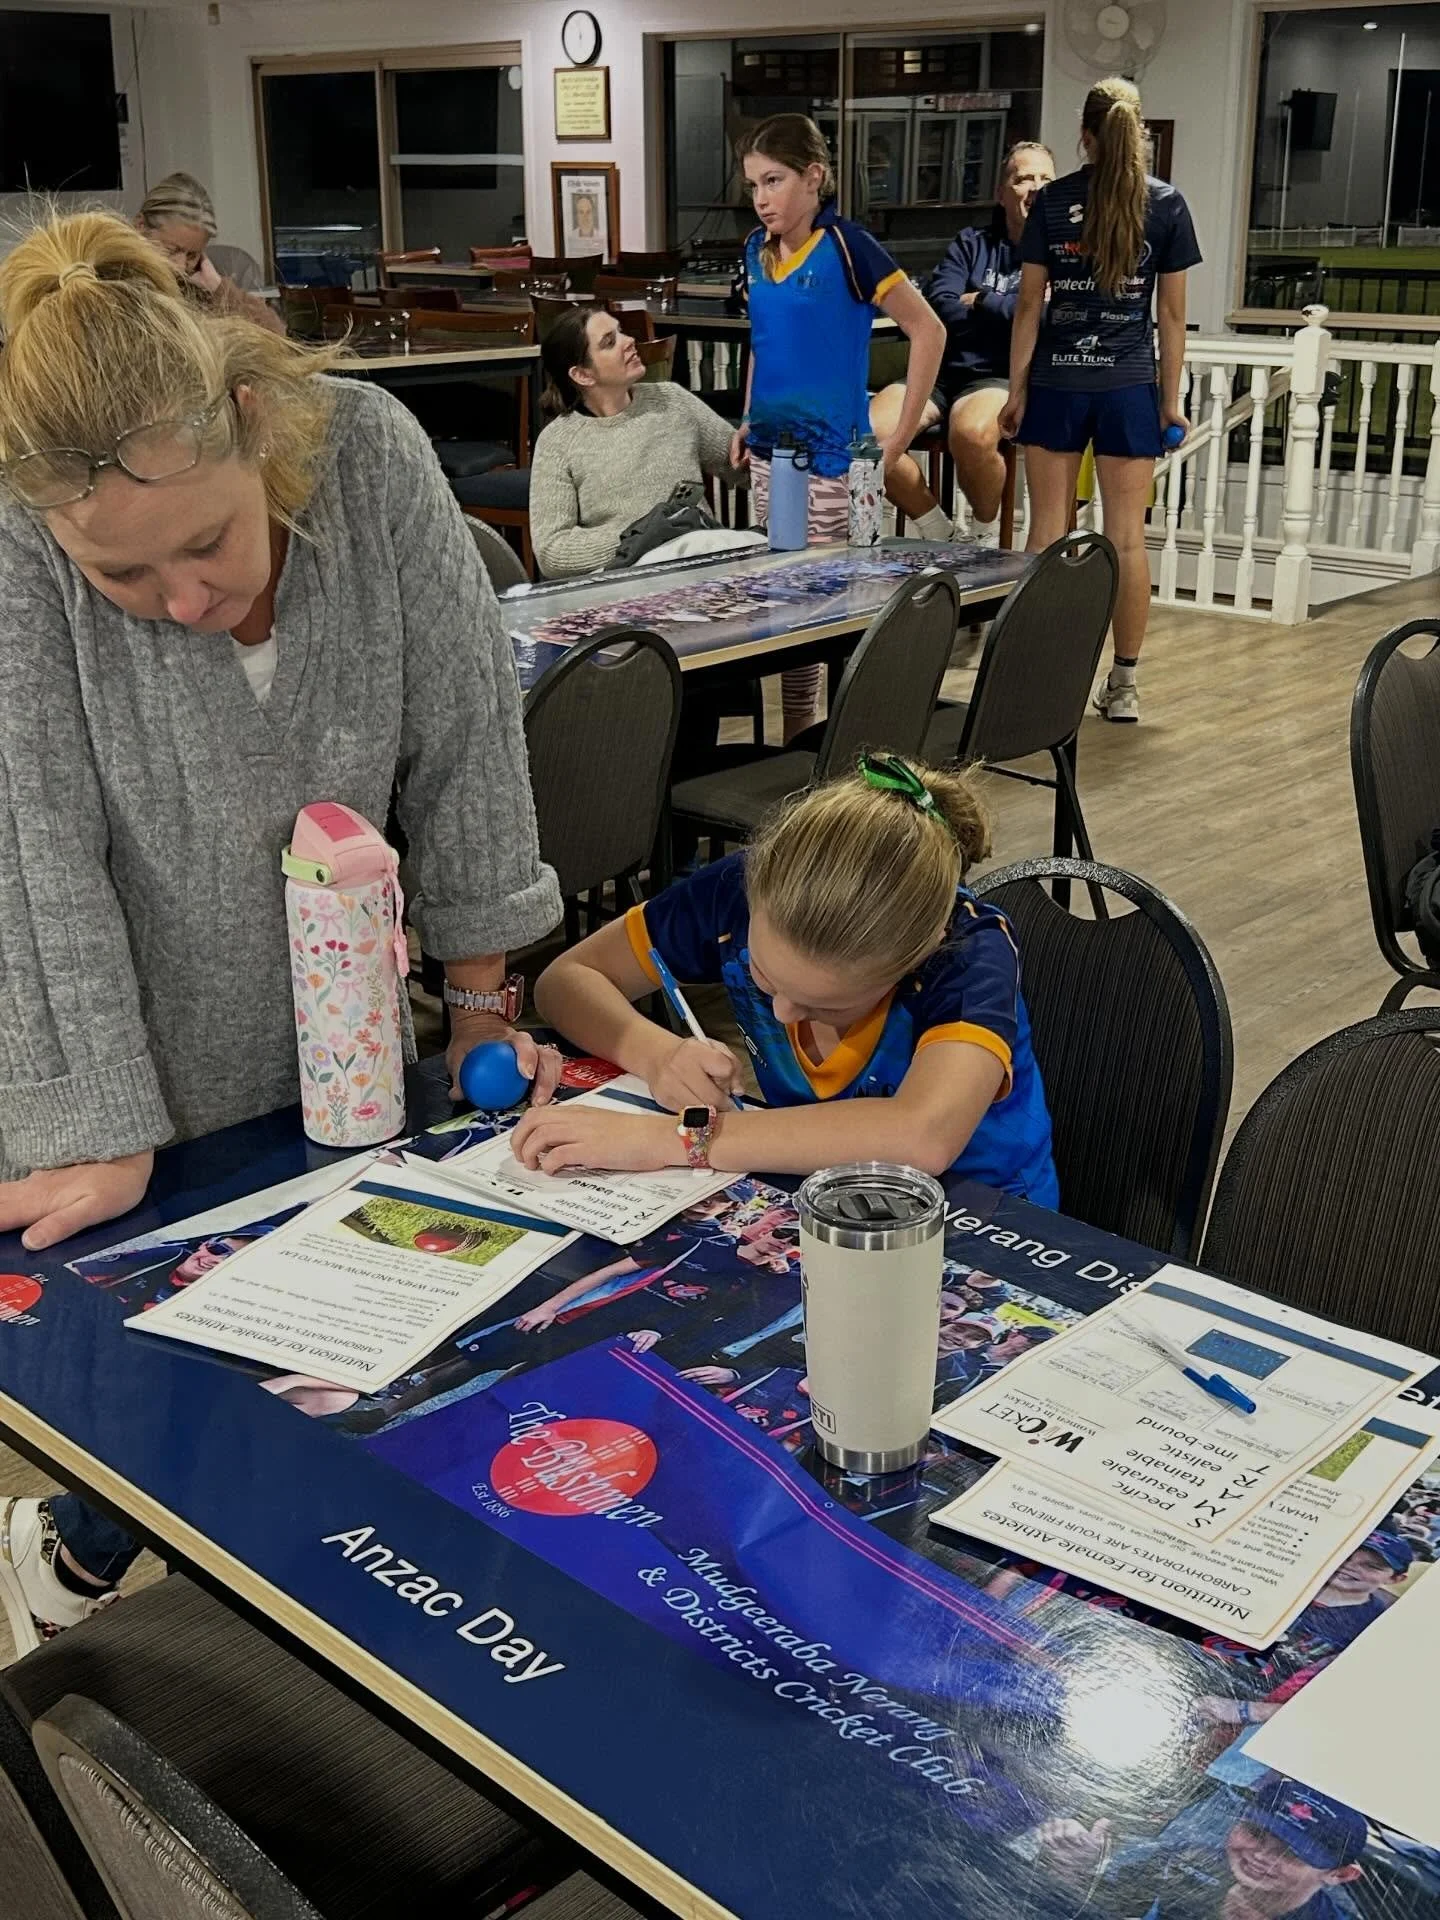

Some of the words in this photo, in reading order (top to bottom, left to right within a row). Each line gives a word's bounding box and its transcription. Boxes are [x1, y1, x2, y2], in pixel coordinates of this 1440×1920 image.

[1052, 353, 1080, 362] ELITE
[1081, 354, 1116, 363] TILING
[175, 1311, 233, 1331] Athletes
[202, 1303, 244, 1318] FRIENDS
[242, 1314, 272, 1326] YOUR
[231, 1326, 286, 1346] Female
[274, 1322, 293, 1331] ARE
[284, 1340, 308, 1353] for
[295, 1327, 383, 1354] CARBOHYDRATES
[308, 1347, 376, 1372] Nutrition
[508, 1402, 568, 1446] The
[1135, 1416, 1238, 1461] ime-bound
[1125, 1449, 1205, 1487] ttainable
[1159, 1443, 1222, 1471] ealistic
[1246, 1464, 1270, 1475] T
[521, 1438, 664, 1529] Bushmen
[1101, 1458, 1188, 1499] easurable
[1232, 1473, 1258, 1488] R
[471, 1482, 490, 1501] Est
[1111, 1480, 1175, 1510] pecific
[1217, 1487, 1244, 1499] A
[1010, 1501, 1064, 1526] FRIENDS
[1193, 1498, 1226, 1517] M
[982, 1510, 1055, 1542] Athletes
[1063, 1521, 1101, 1541] YOUR
[1186, 1517, 1211, 1528] S
[1057, 1539, 1126, 1571] Female
[1103, 1536, 1131, 1550] ARE
[1127, 1567, 1157, 1583] for
[1133, 1547, 1251, 1596] CARBOHYDRATES
[319, 1525, 464, 1619] Anzac
[456, 1606, 565, 1684] Day
[1160, 1578, 1250, 1620] Nutrition
[678, 1548, 837, 1675] Mudgeeraba
[829, 1672, 957, 1742] Nerang
[638, 1566, 667, 1588] &
[662, 1587, 780, 1681] Districts
[774, 1681, 895, 1748] Cricket
[888, 1745, 986, 1796] Club
